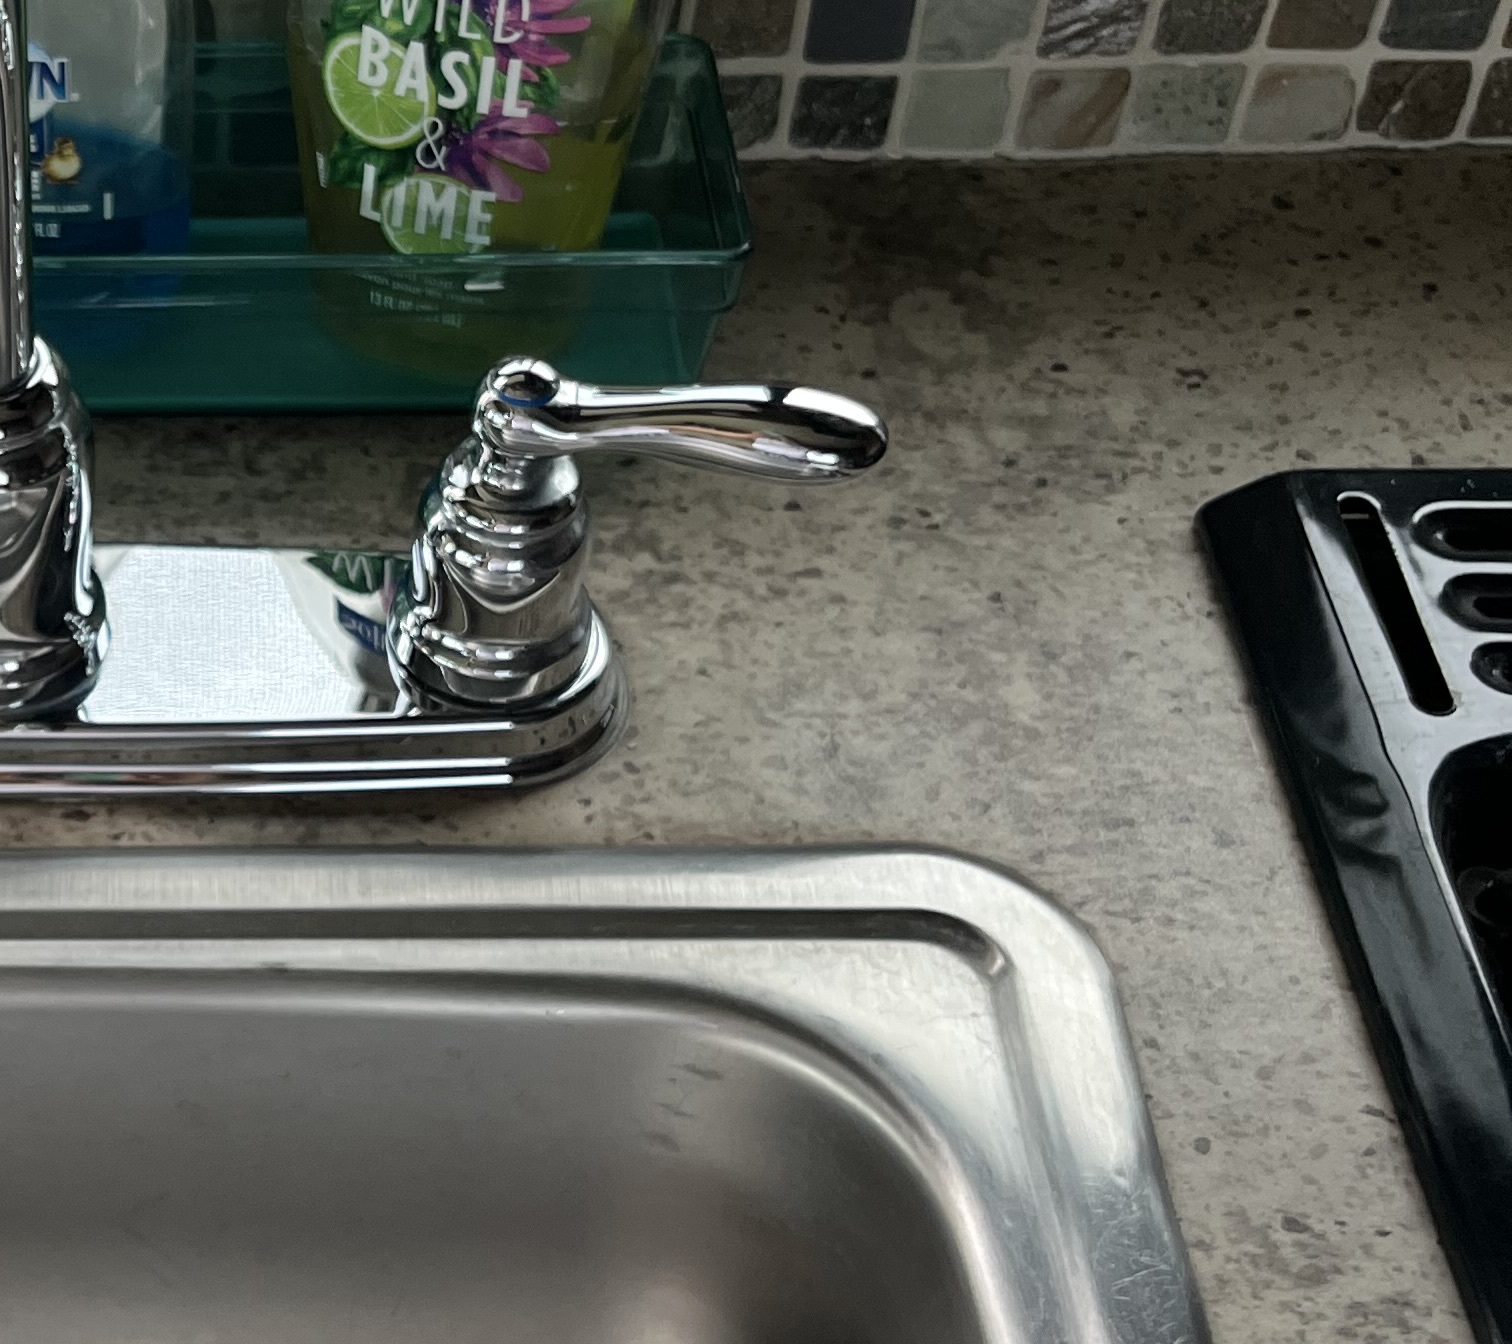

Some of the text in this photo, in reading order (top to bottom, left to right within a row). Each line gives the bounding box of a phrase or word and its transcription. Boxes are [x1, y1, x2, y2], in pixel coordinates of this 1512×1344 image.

[357, 24, 530, 118] BASIL
[415, 116, 447, 172] &
[360, 163, 498, 246] LIME
